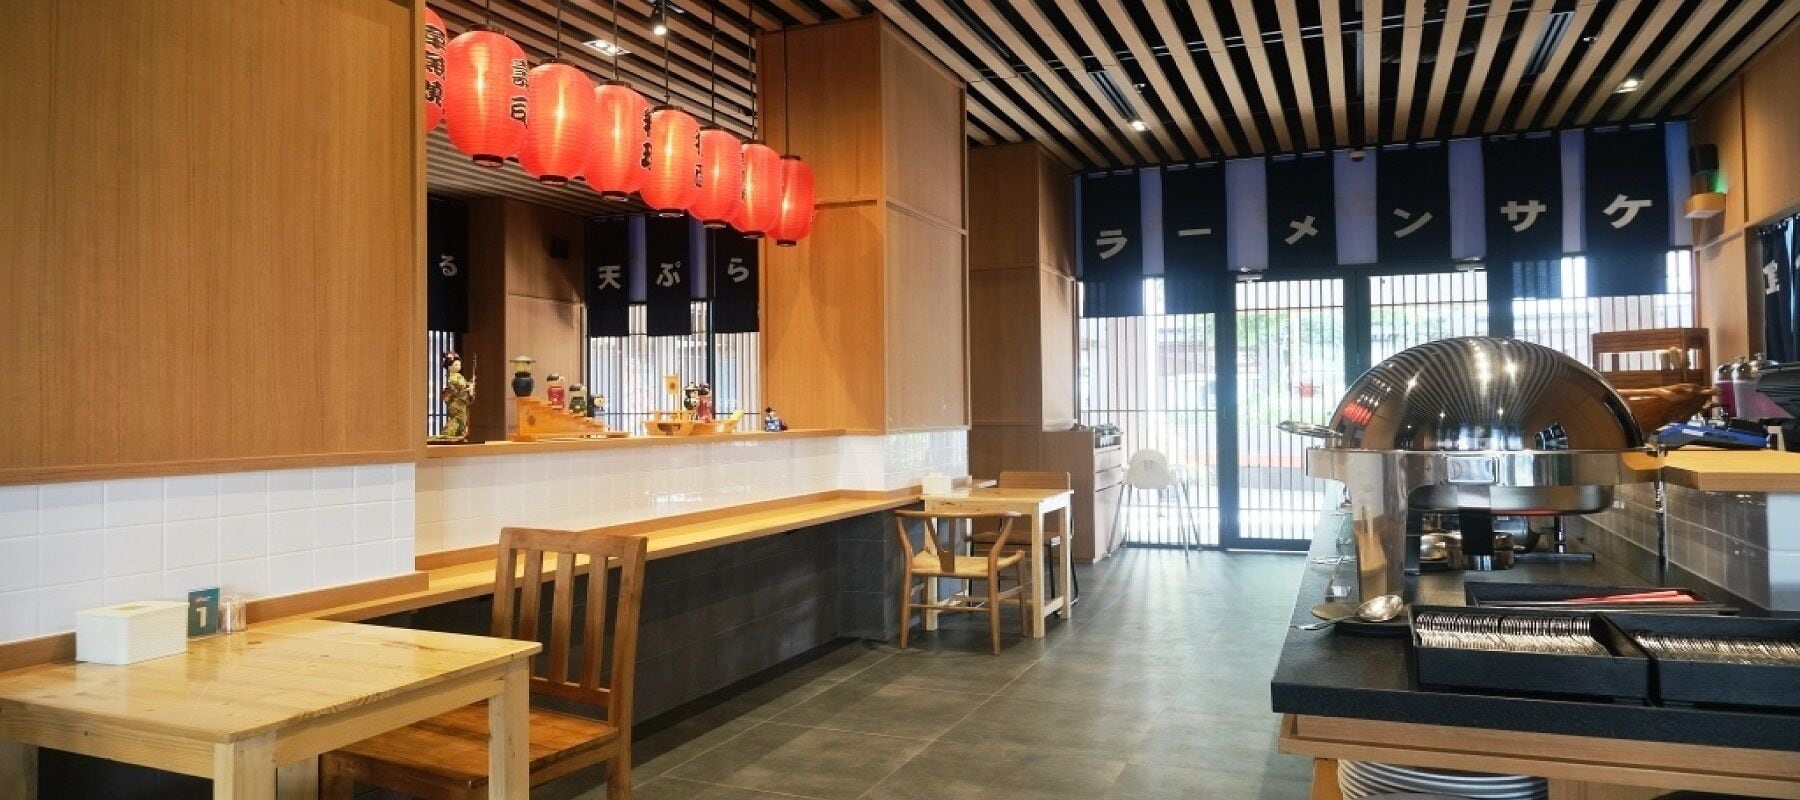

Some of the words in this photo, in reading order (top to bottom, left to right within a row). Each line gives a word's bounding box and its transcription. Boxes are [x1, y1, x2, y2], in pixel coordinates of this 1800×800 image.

[598, 258, 750, 290] 天ぷら
[198, 606, 207, 627] 1
